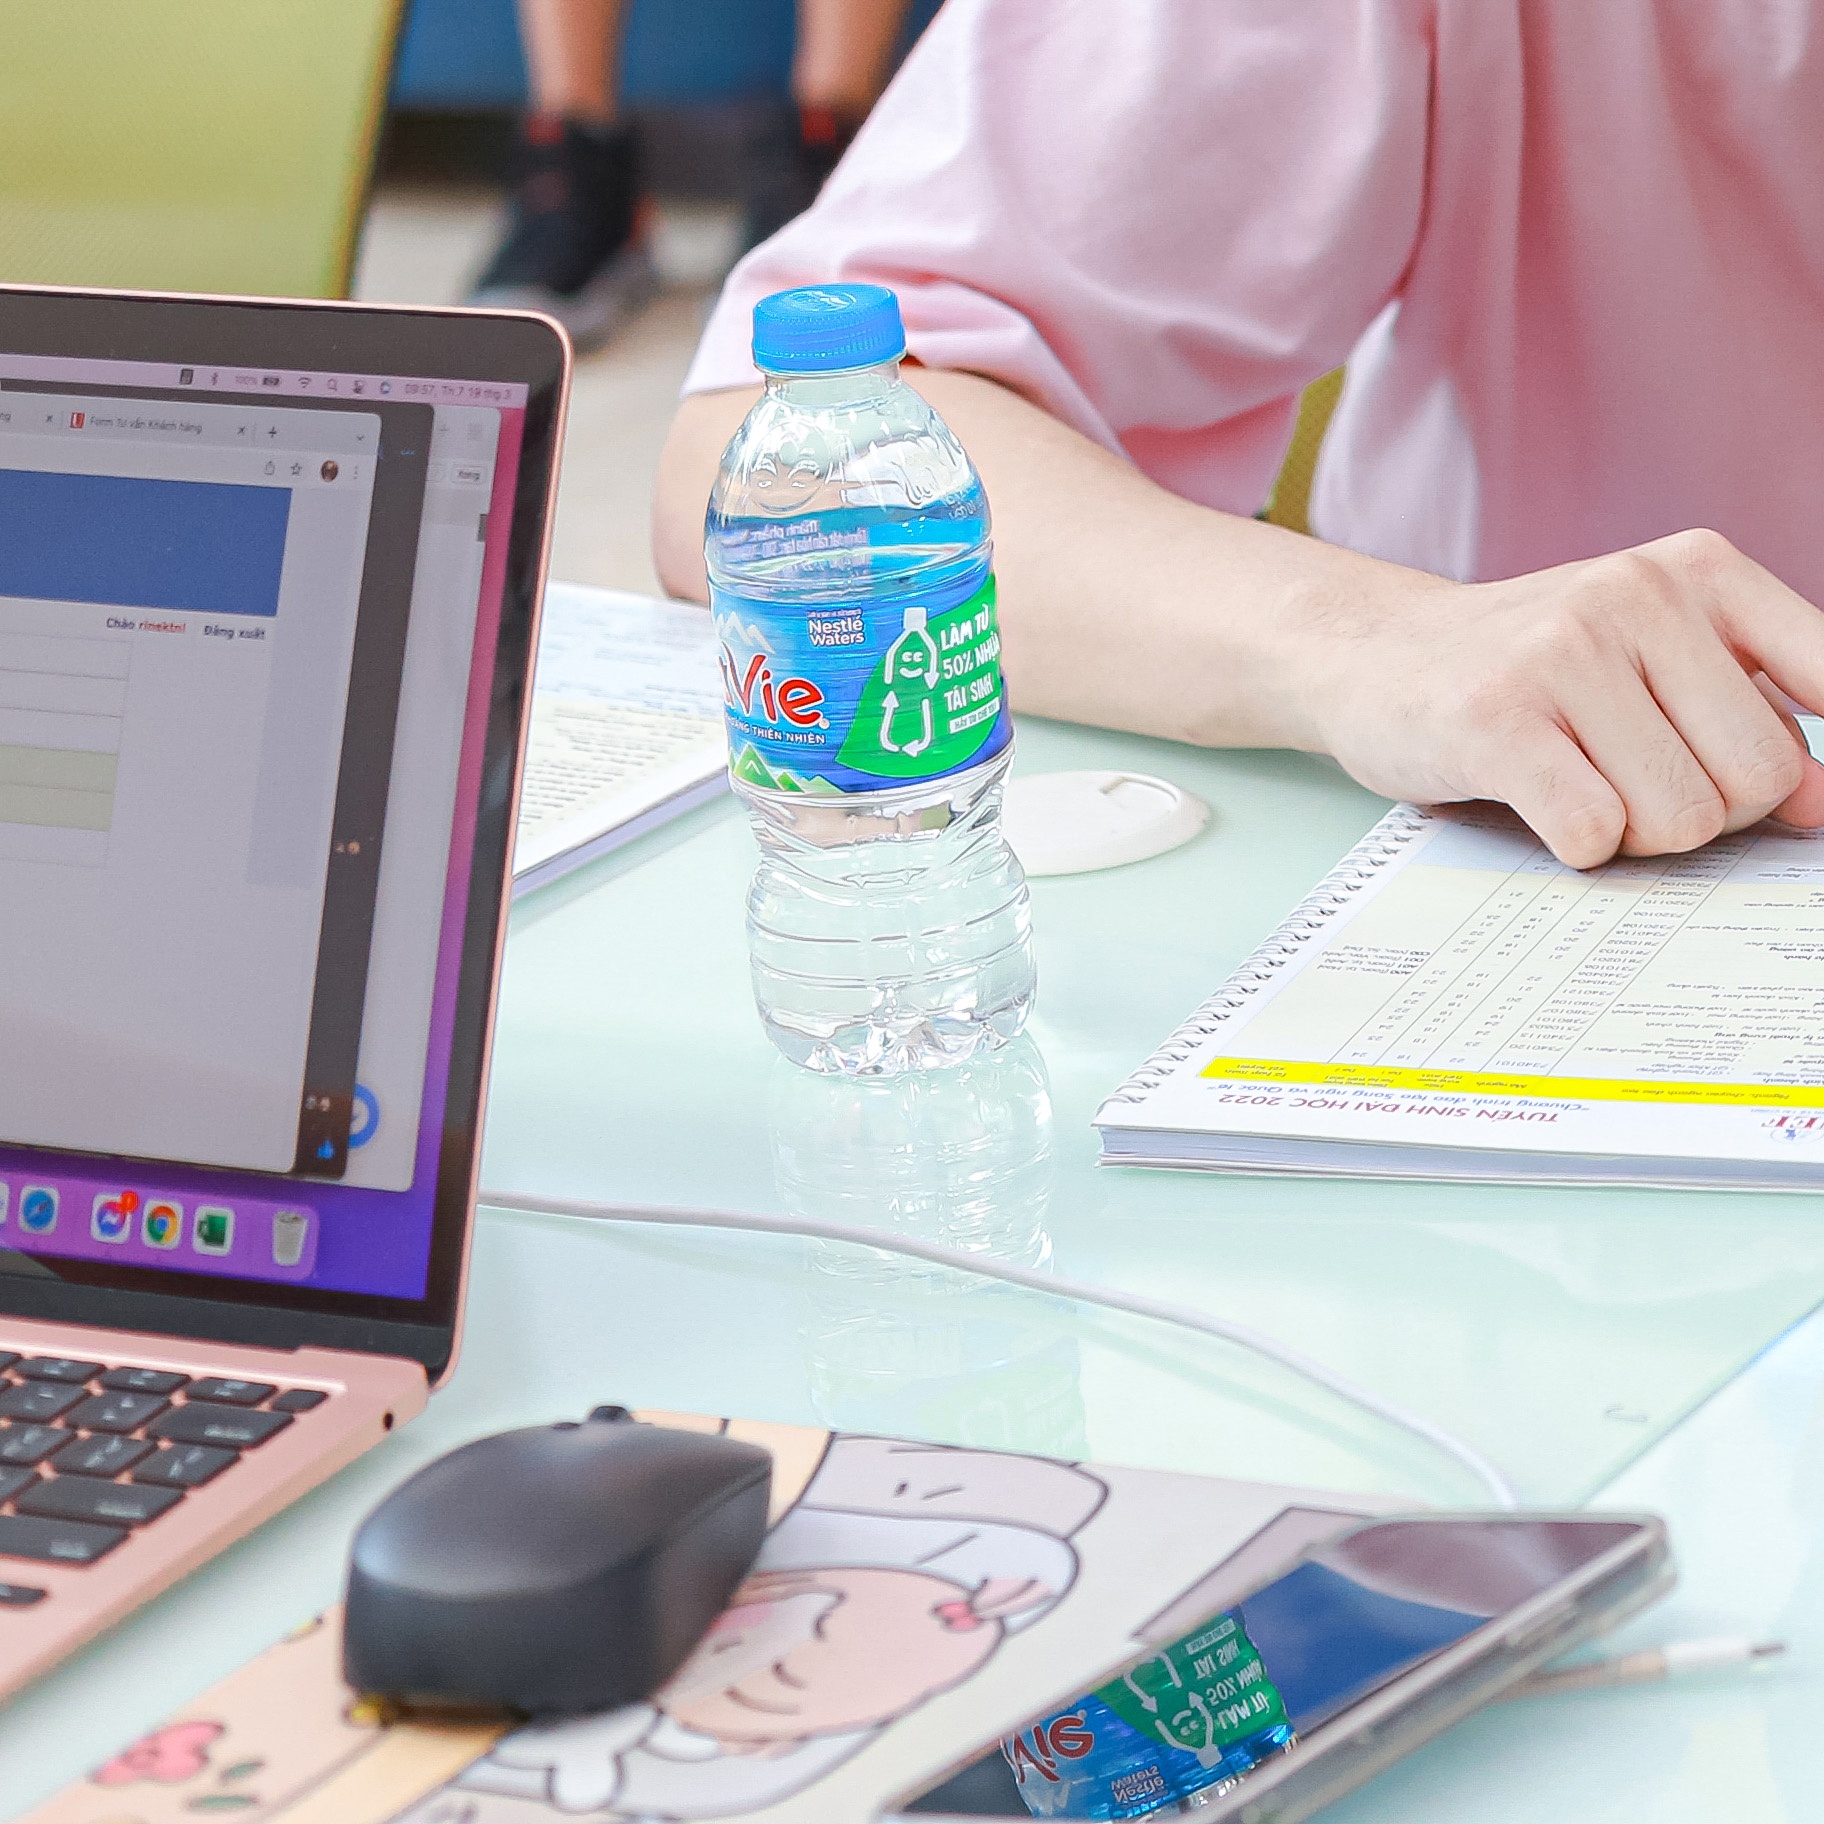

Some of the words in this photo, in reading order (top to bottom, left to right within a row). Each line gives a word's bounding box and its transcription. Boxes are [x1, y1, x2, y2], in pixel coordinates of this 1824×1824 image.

[808, 617, 864, 635] Nestlé
[941, 620, 973, 650] LÀM
[975, 603, 989, 635] TỪ
[810, 632, 865, 647] Waters
[943, 650, 974, 679] 50%
[720, 641, 824, 726] Vie
[944, 685, 967, 712] TÁI
[970, 672, 993, 702] SINH
[752, 727, 783, 740] THIÊN
[786, 732, 826, 744] NHIÊN
[1218, 1094, 1282, 1107] 2022
[1288, 1095, 1348, 1111] HỌC
[1351, 1090, 1395, 1100] Song
[1433, 1096, 1467, 1105] đào
[1472, 1098, 1512, 1106] trình
[1352, 1097, 1402, 1114] ĐẠI
[1405, 1103, 1470, 1118] SINH
[1476, 1108, 1559, 1124] TUYỂN
